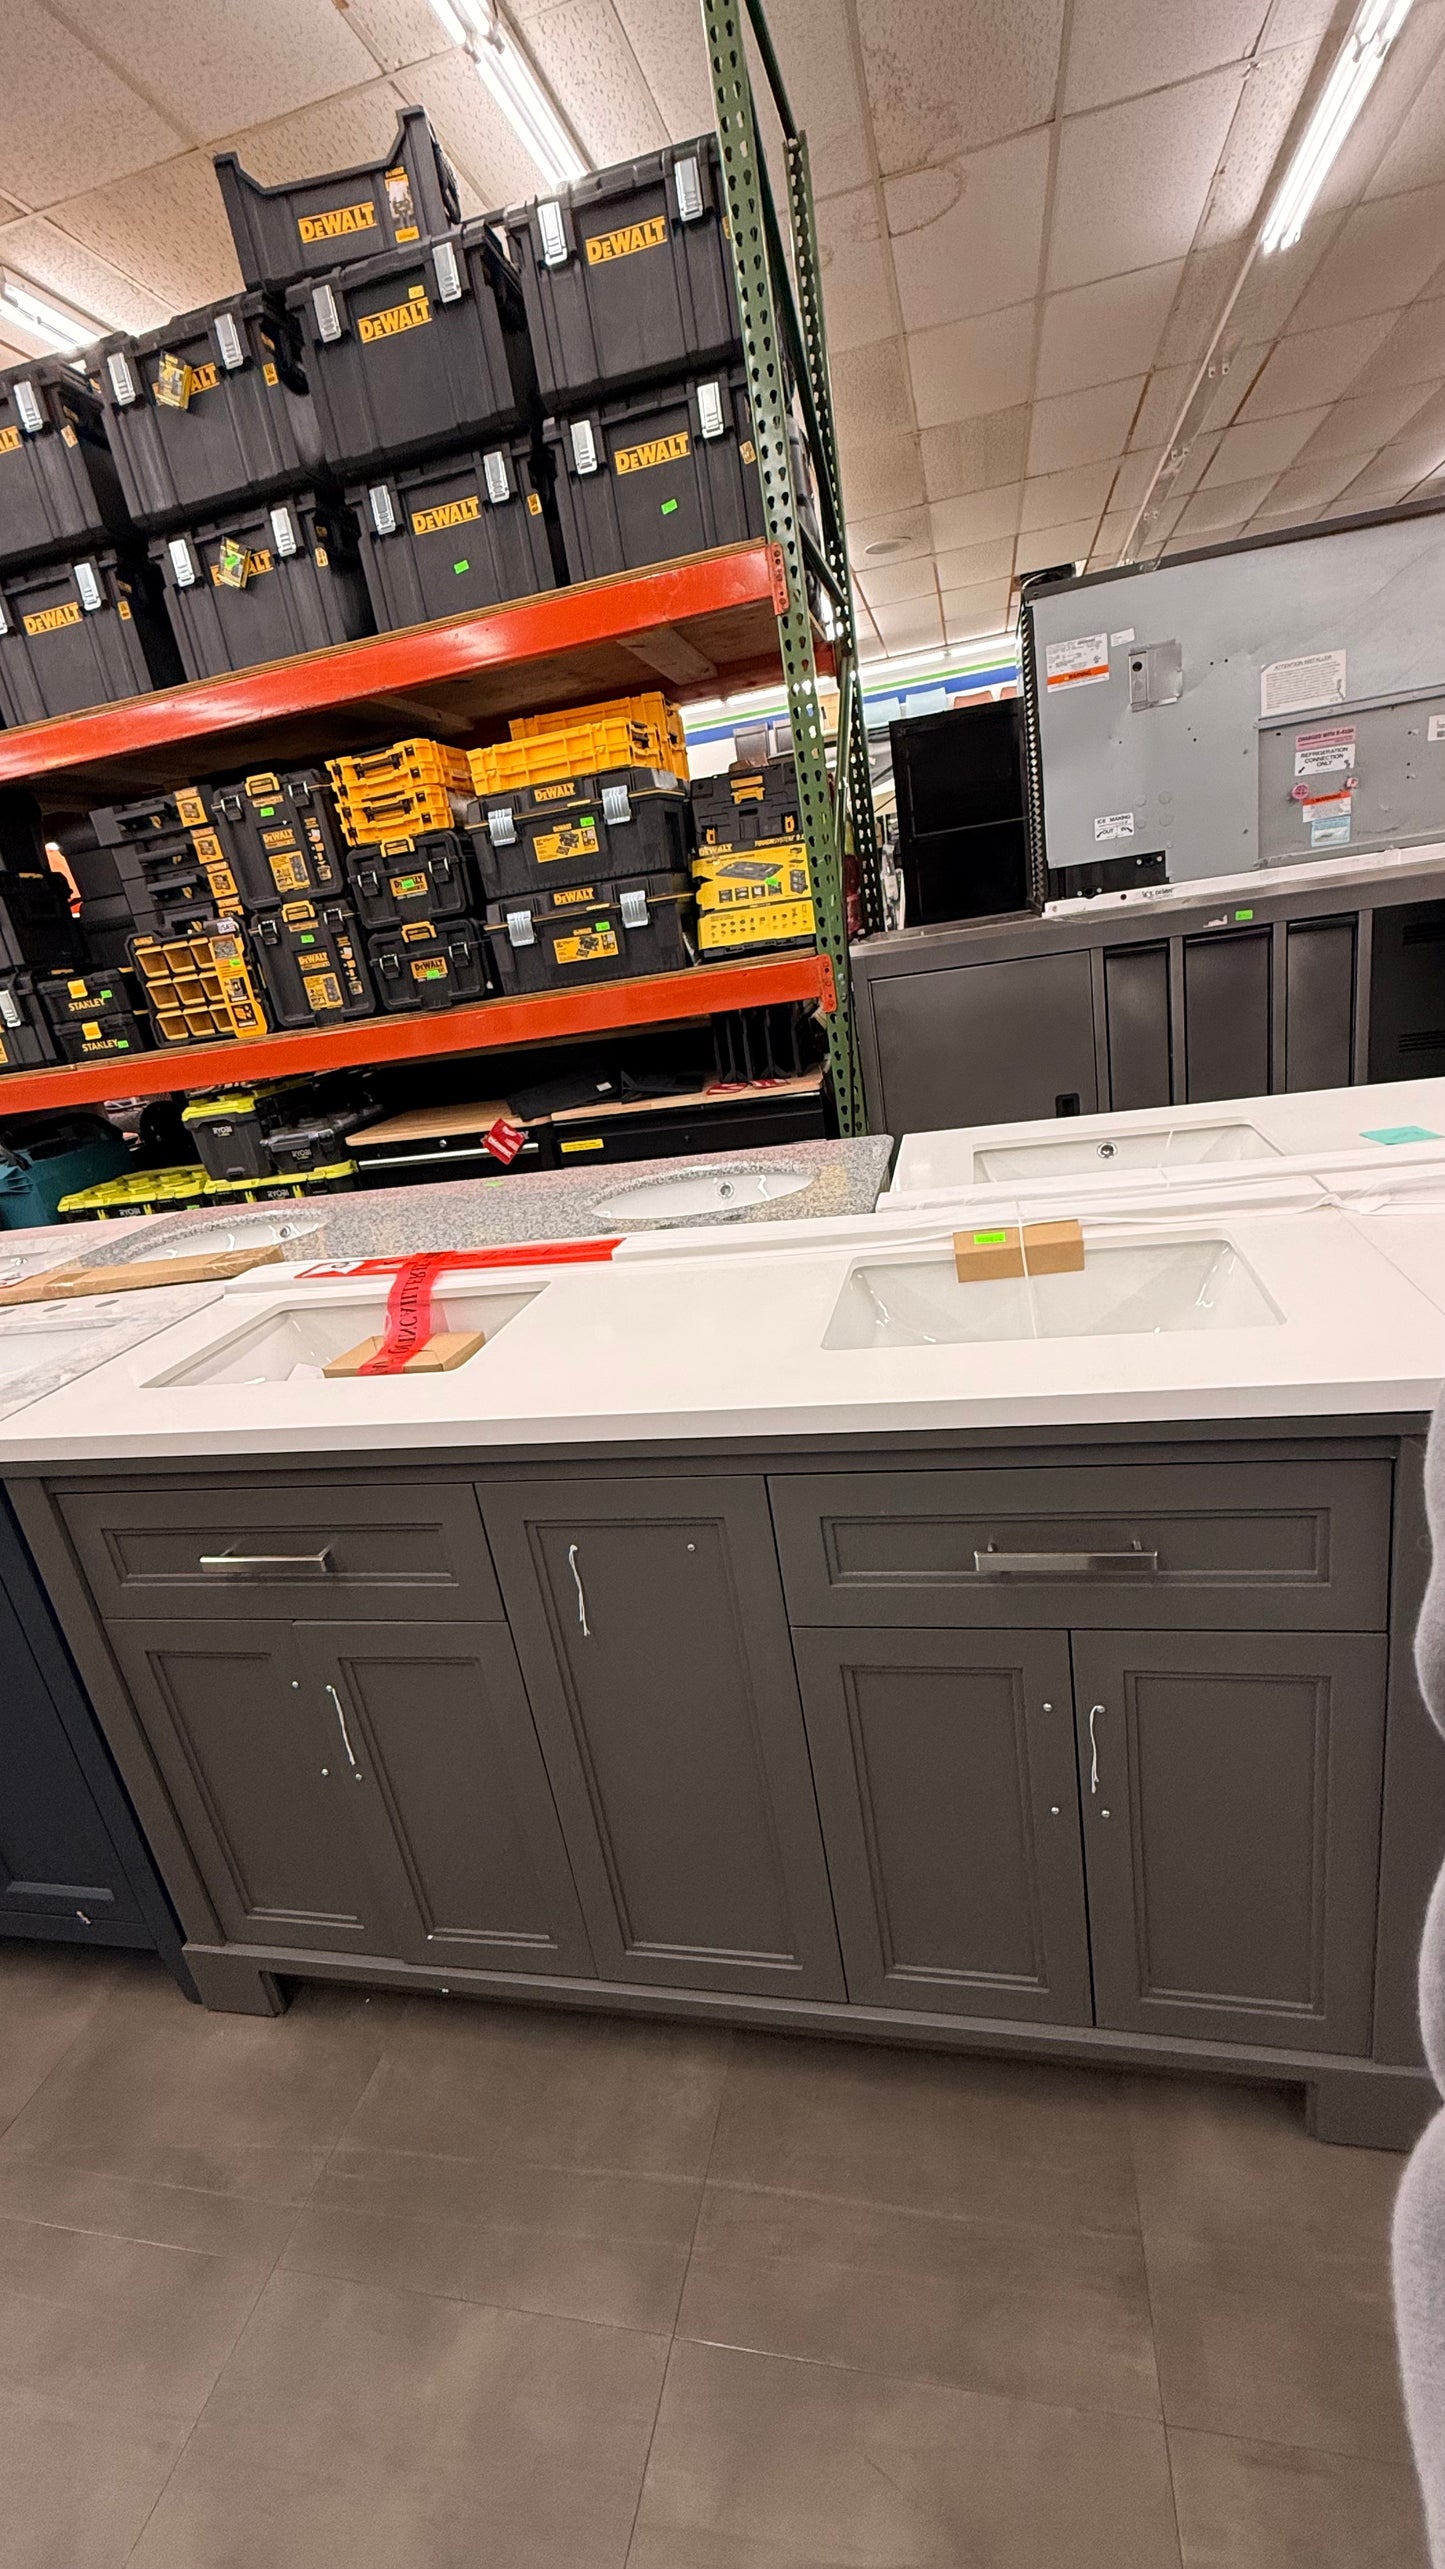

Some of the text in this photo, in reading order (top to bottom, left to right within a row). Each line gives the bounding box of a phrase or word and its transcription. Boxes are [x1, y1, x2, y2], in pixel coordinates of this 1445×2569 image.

[1300, 746, 1348, 758] REFRIGERATION
[1304, 753, 1344, 764] CONNECTION
[68, 998, 105, 1012] STANLEY
[82, 1038, 118, 1053] STANLEY
